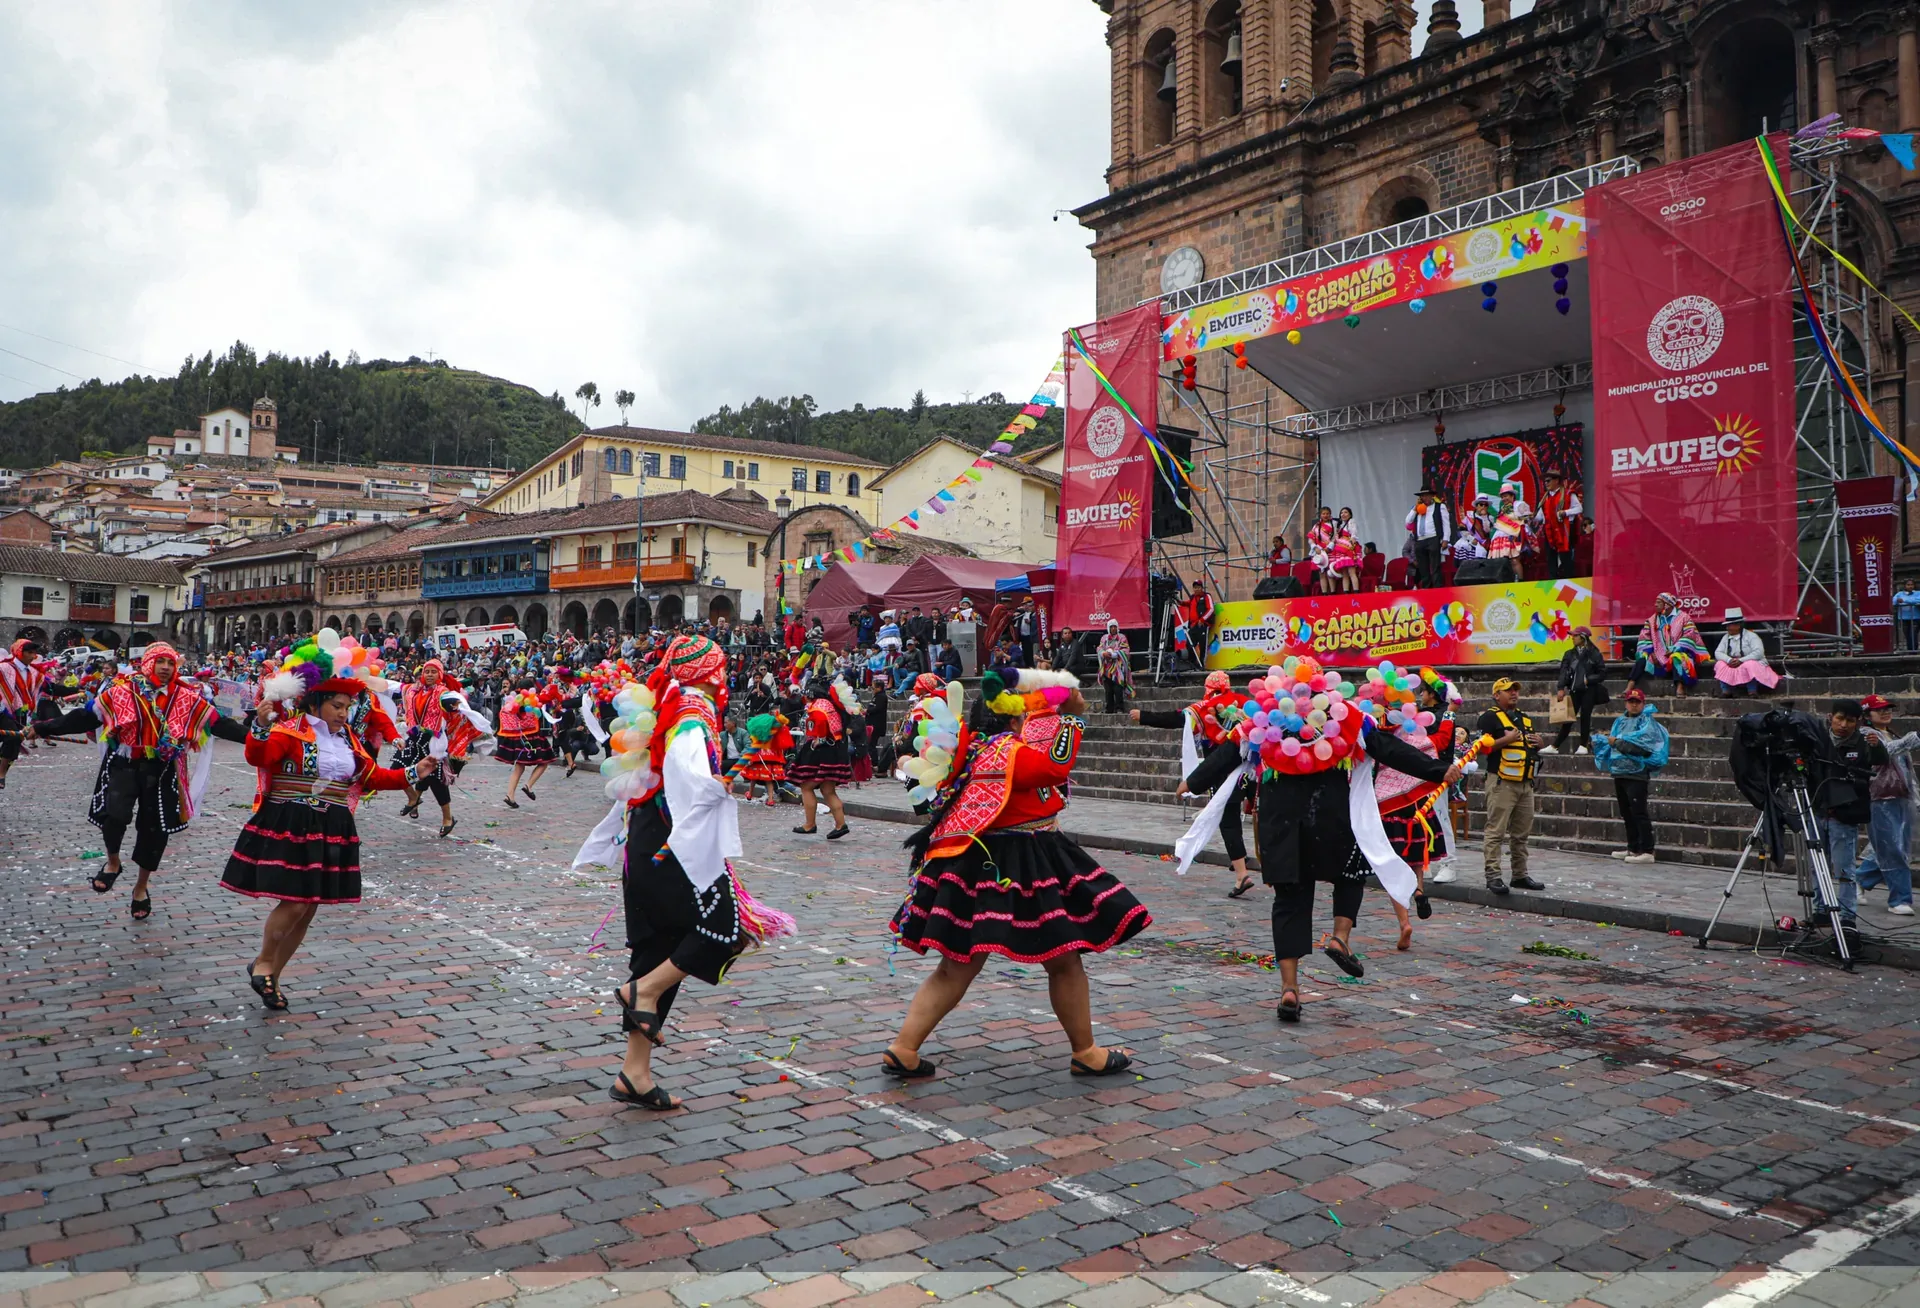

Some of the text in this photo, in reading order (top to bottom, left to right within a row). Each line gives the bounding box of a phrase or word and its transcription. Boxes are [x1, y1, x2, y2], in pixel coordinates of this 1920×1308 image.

[1660, 197, 1706, 215] QOSQO
[1306, 258, 1394, 304] CARNAVAL
[1473, 268, 1497, 279] CUSCO
[1209, 308, 1262, 333] EMUFEC
[1608, 362, 1769, 396] MUNICIPALIDAD PROVINCIAL DEL
[1654, 381, 1718, 404] CUSCO
[1611, 433, 1741, 471] EMUFEC
[1066, 462, 1104, 473] MUNICIPALIDAD
[1105, 457, 1133, 466] PROVINCIAL
[1089, 466, 1119, 480] CUSCO
[1066, 502, 1132, 525] EMUFEC
[1864, 543, 1879, 597] EMUFEC
[1676, 597, 1710, 609] OSQO
[1313, 602, 1424, 636] CARNAVAL
[1222, 628, 1276, 642] EMUFEC
[1371, 644, 1409, 655] KACHARPARI
